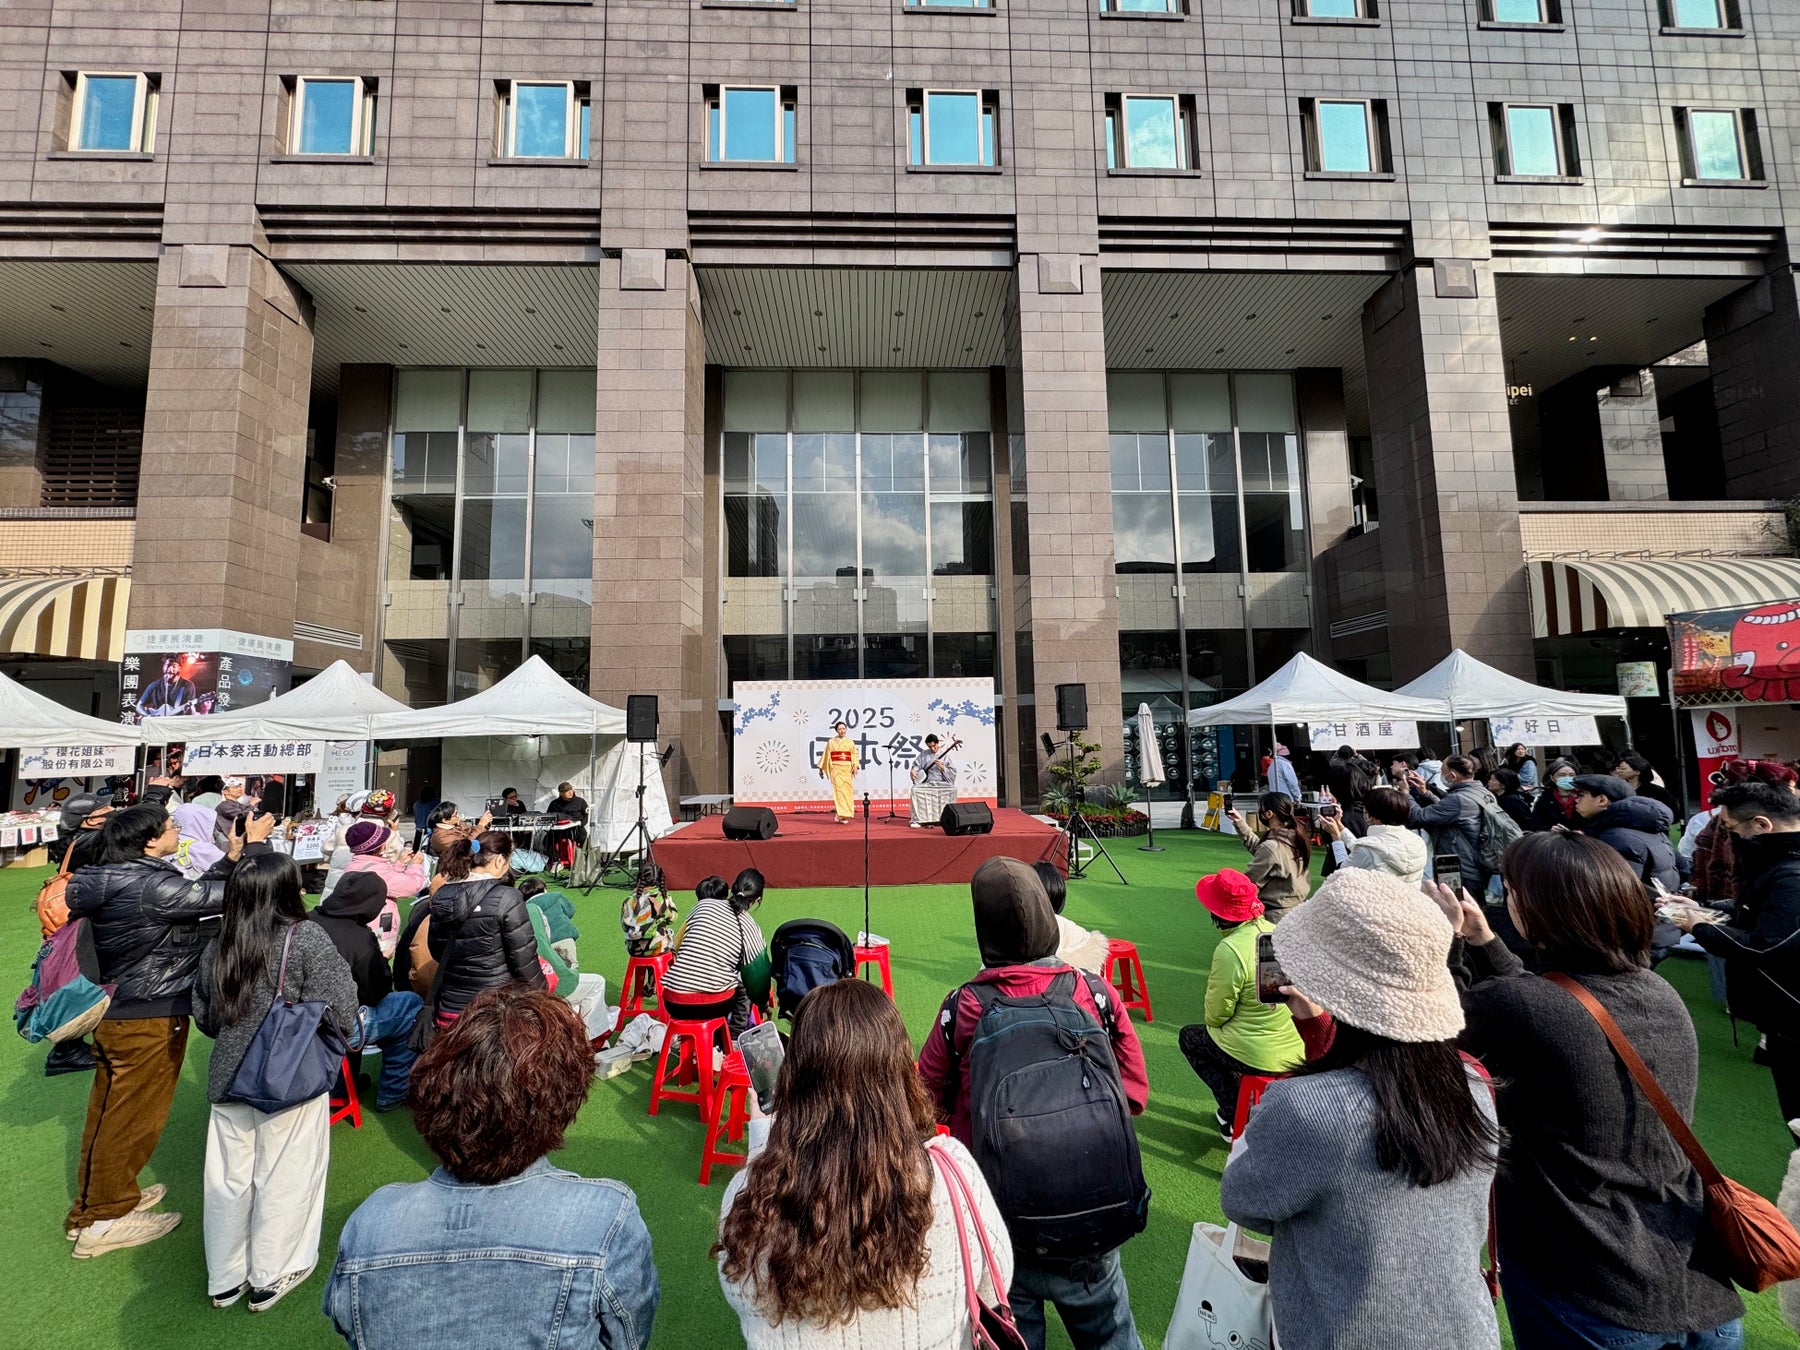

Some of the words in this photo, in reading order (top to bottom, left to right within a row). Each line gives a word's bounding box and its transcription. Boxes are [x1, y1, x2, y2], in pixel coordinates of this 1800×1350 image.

[119, 656, 141, 726] 樂團表演
[828, 706, 895, 730] 2025
[1332, 722, 1394, 737] 甘酒屋
[1524, 719, 1561, 734] 好日
[55, 746, 104, 757] 櫻花姐妹
[198, 743, 312, 758] 日本祭活動總部
[42, 758, 115, 770] 股份有限公司
